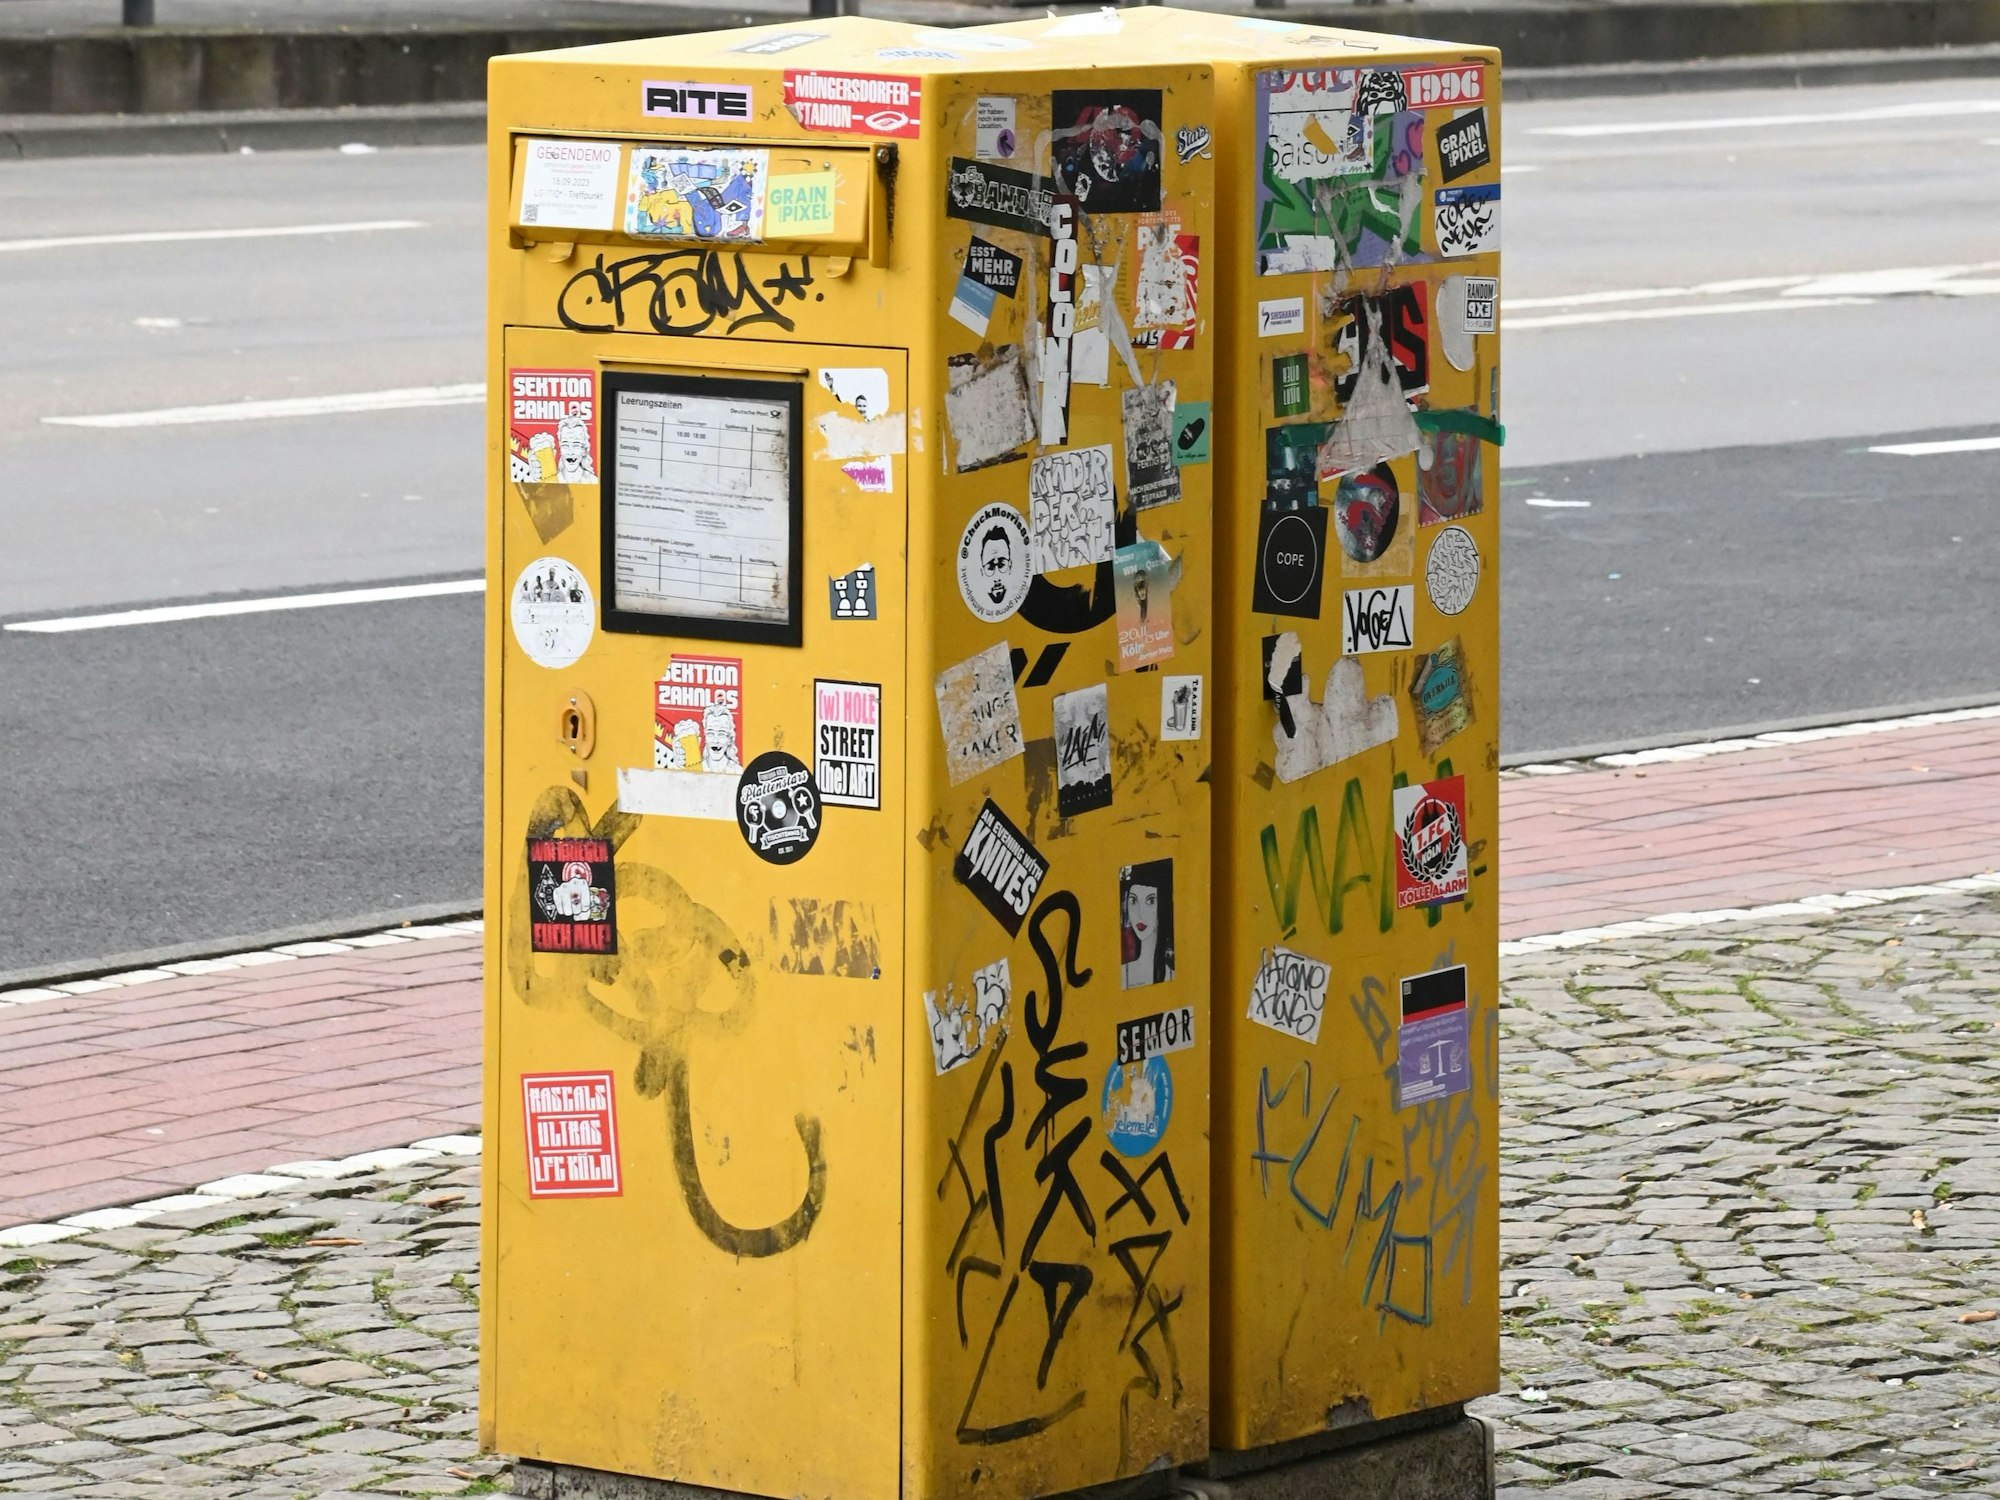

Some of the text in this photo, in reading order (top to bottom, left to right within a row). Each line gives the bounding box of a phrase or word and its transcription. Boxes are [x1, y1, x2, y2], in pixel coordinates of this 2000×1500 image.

[795, 72, 910, 106] MÜNGERSDORFER
[1411, 70, 1480, 104] 1996
[647, 88, 748, 117] RITE
[796, 102, 851, 128] STADION
[1440, 122, 1480, 155] GRAIN
[537, 146, 611, 162] GEGENDEMO
[770, 186, 827, 205] GRAIN
[970, 246, 996, 258] ESST
[971, 257, 1014, 275] MEHR
[984, 274, 1016, 287] NAZIS
[1467, 283, 1494, 299] RANDOM
[513, 377, 592, 398] SEKTION
[621, 396, 682, 410] Leerungszeiten
[730, 408, 755, 416] Deutsche
[1276, 551, 1305, 568] COPE
[844, 691, 876, 725] HOLE
[821, 724, 874, 759] STREET
[741, 770, 808, 804] Plattenstars
[849, 763, 875, 798] ART
[992, 820, 1025, 861] EVENING
[1422, 841, 1442, 865] KÖLN
[963, 818, 1037, 916] KNIVES
[1119, 1009, 1191, 1064] SEMOR
[529, 1084, 608, 1113] RASCALS
[537, 1120, 602, 1148] ULTRAS
[567, 1153, 613, 1181] KÖLN
